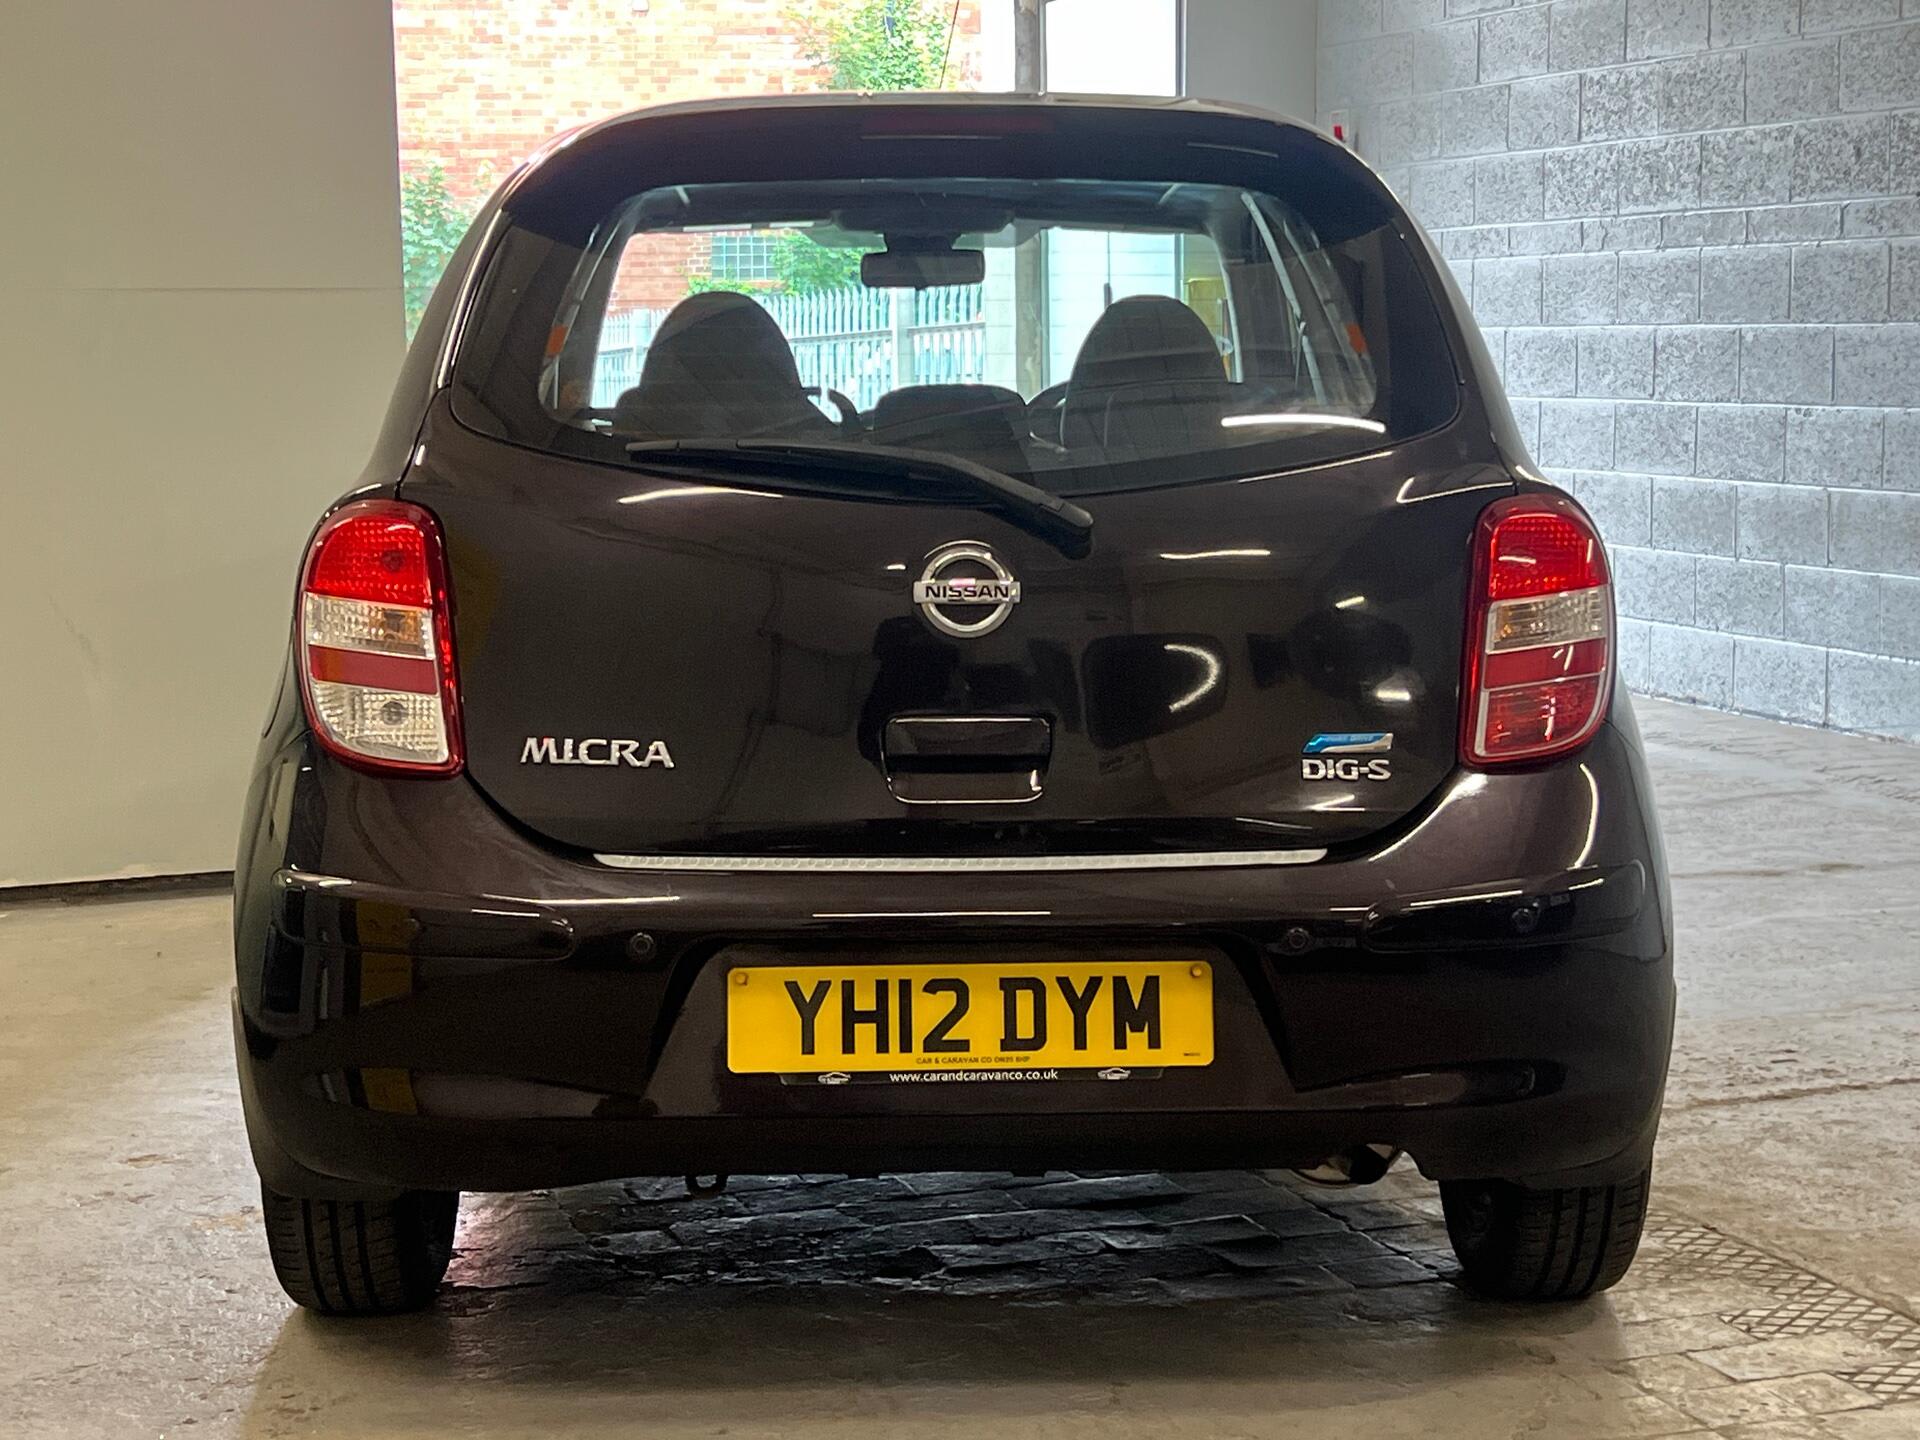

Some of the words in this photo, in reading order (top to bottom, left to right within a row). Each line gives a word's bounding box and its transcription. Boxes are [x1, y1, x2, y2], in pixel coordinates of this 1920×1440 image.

[925, 585, 1009, 598] NISSAN
[520, 736, 675, 769] MICRA
[1302, 759, 1392, 780] DIG-S
[783, 978, 970, 1056] YH12
[999, 975, 1161, 1053] DYM
[941, 1056, 979, 1065] CARAVAN
[981, 1056, 992, 1064] CO
[889, 1069, 1058, 1082] www.carandcaravanco.co.uk
